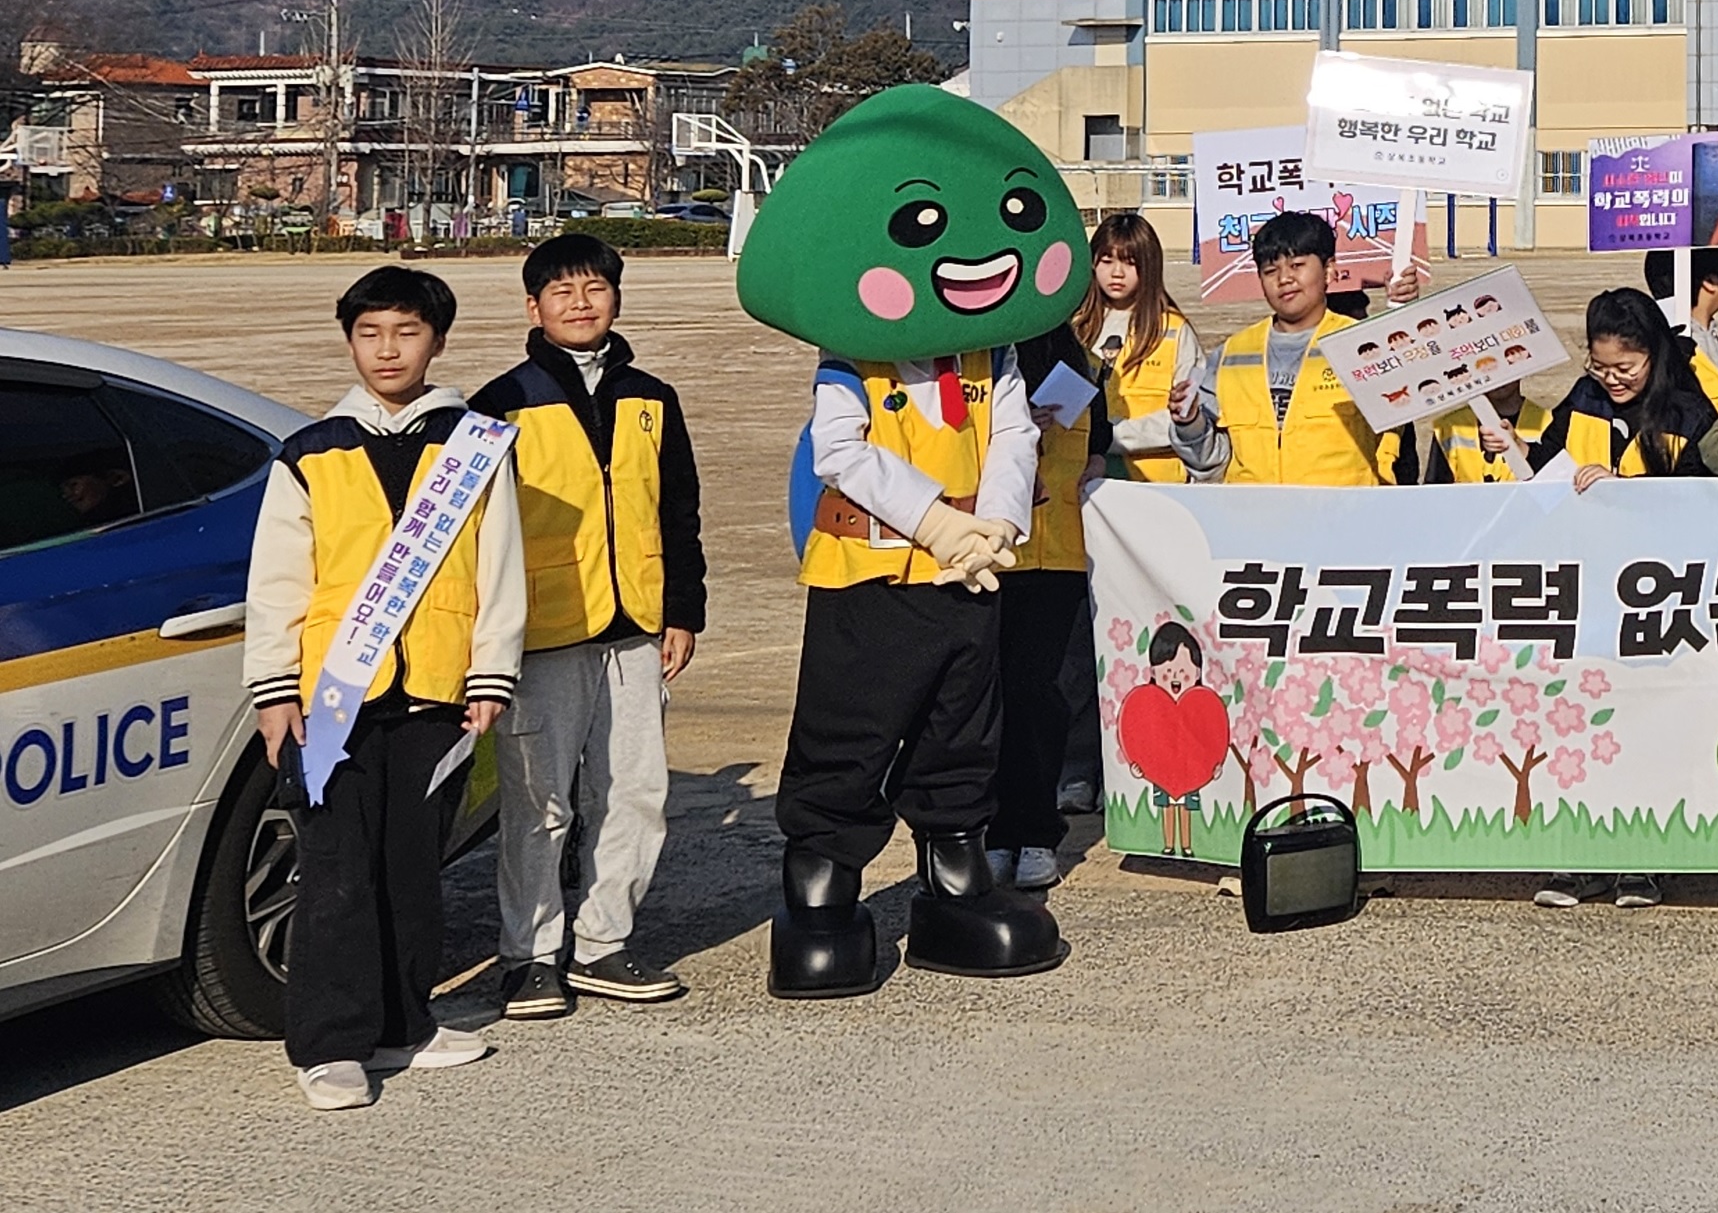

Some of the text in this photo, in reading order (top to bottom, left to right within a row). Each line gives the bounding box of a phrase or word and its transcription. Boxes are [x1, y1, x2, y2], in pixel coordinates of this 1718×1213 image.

[1337, 117, 1498, 151] 행복한 우리 학교
[1403, 340, 1443, 364] 우정을
[1449, 318, 1542, 362] 주먹보다 대화를
[449, 452, 492, 510] 따돌림
[346, 456, 462, 646] 우리 함께 만들어요!
[422, 512, 457, 553] 없는
[383, 555, 431, 618] 행복한
[1216, 562, 1581, 661] 학교폭력
[357, 621, 391, 667] 학교
[0, 695, 189, 805] OLICE
